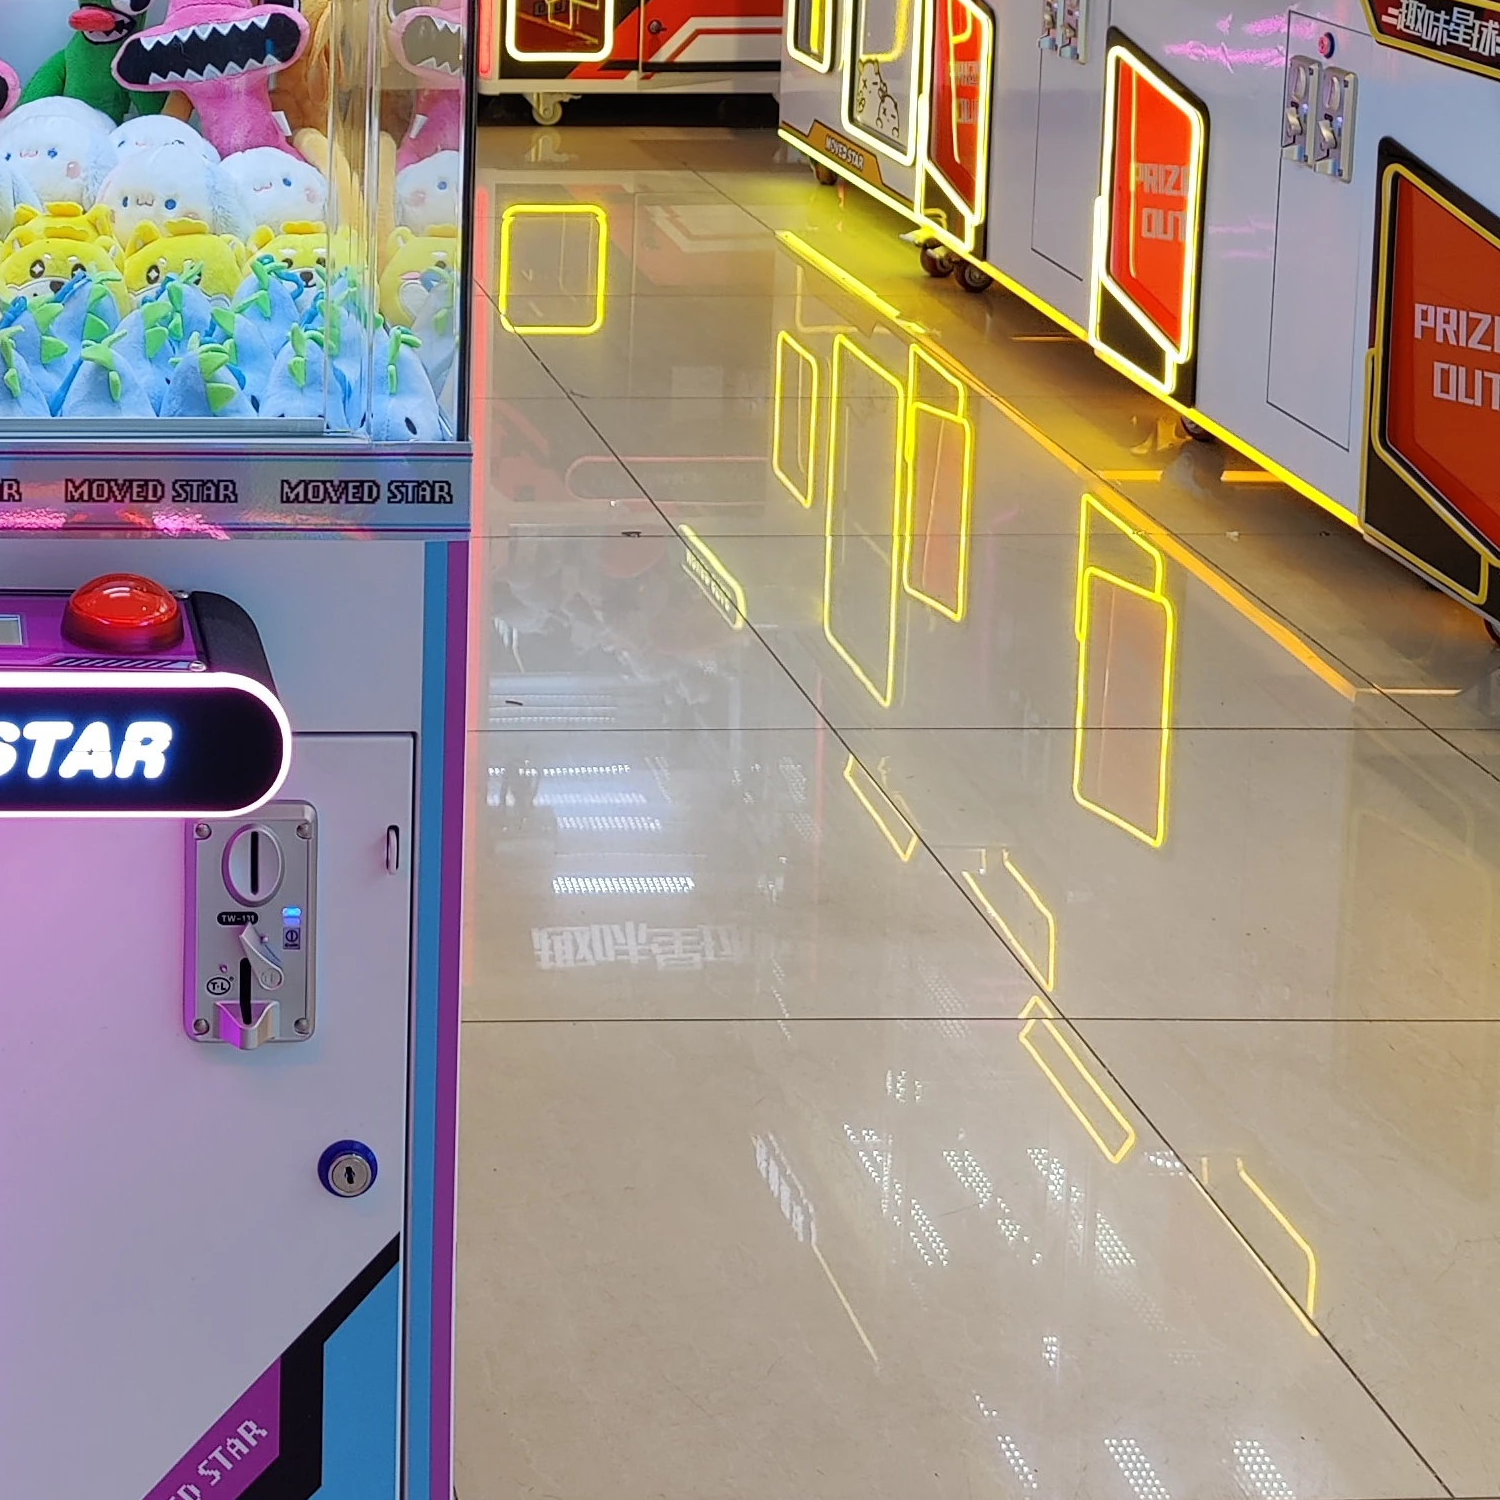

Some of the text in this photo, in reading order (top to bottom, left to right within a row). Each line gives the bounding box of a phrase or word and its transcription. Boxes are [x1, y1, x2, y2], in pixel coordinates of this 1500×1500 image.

[1414, 303, 1500, 354] PRIZ
[64, 478, 237, 503] MOVED STAR
[280, 480, 452, 504] MOVED STAR
[198, 1420, 268, 1486] STAR
